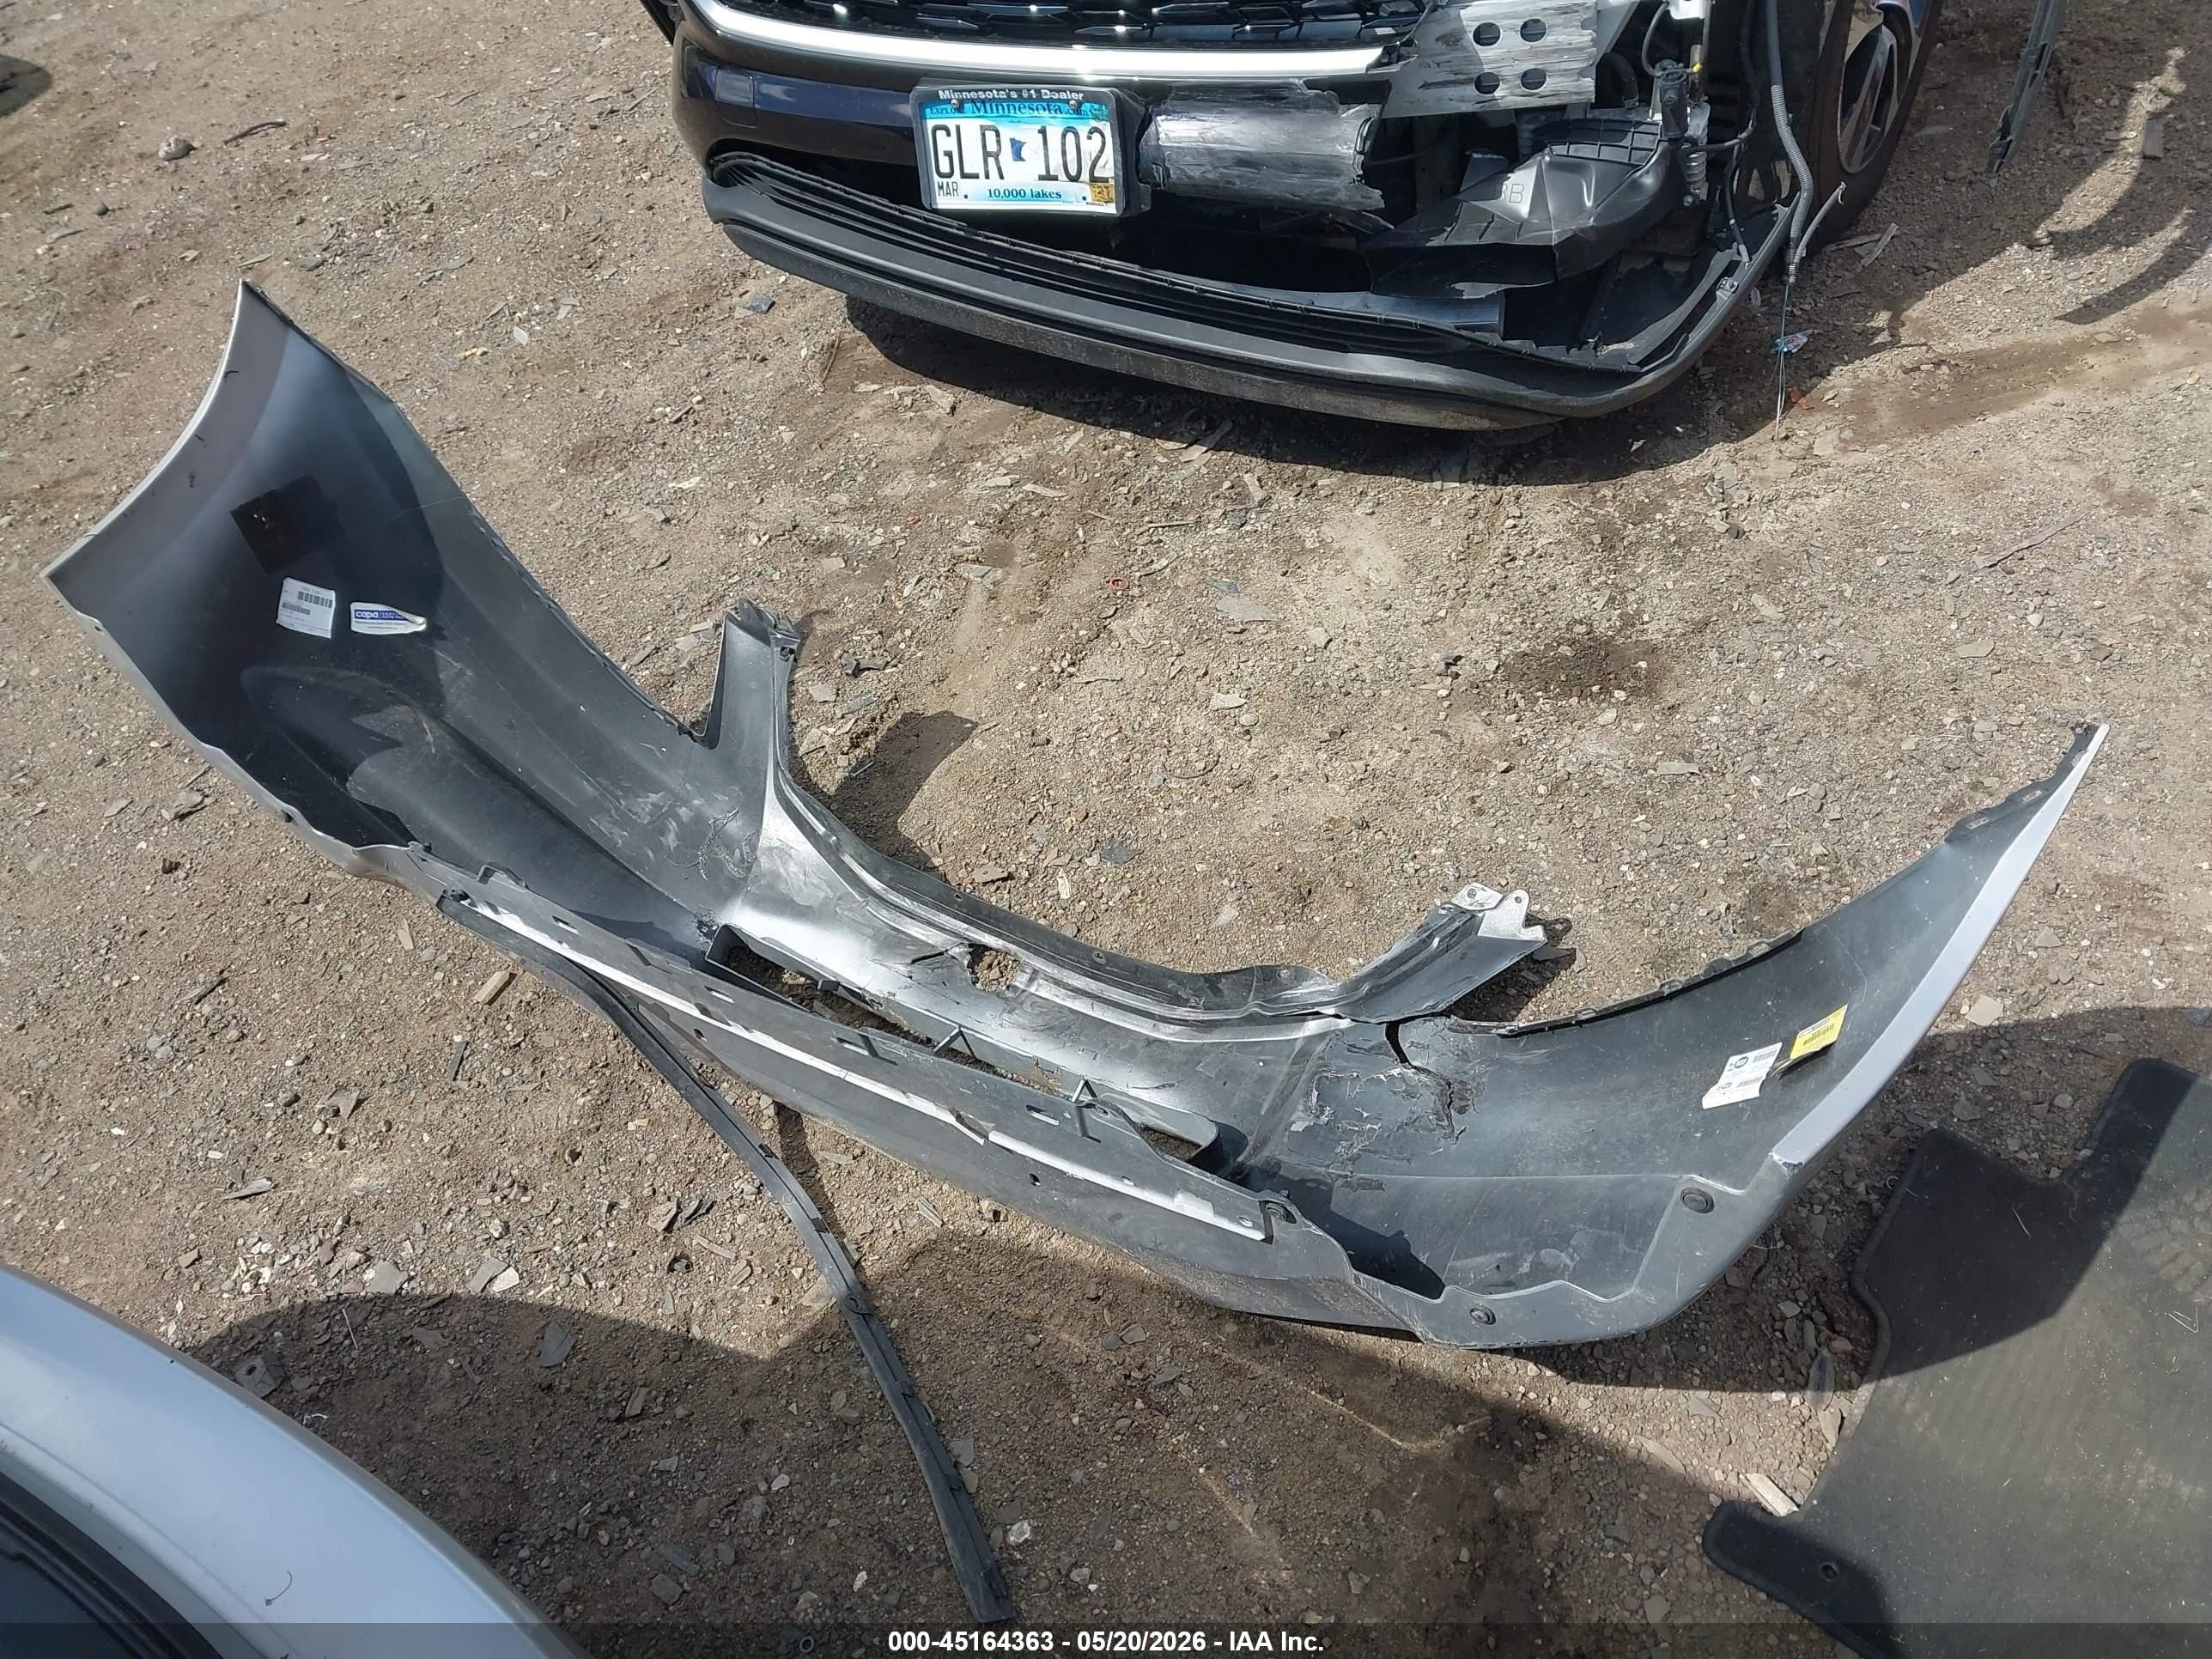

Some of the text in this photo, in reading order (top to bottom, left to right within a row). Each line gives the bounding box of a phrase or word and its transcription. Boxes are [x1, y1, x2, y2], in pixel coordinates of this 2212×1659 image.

[939, 88, 1084, 100] Minnesota's #1 Dealer
[931, 124, 1109, 183] GLR 102
[938, 181, 959, 198] MAR
[988, 188, 1061, 199] 10,000 lakes
[356, 611, 379, 619] capa
